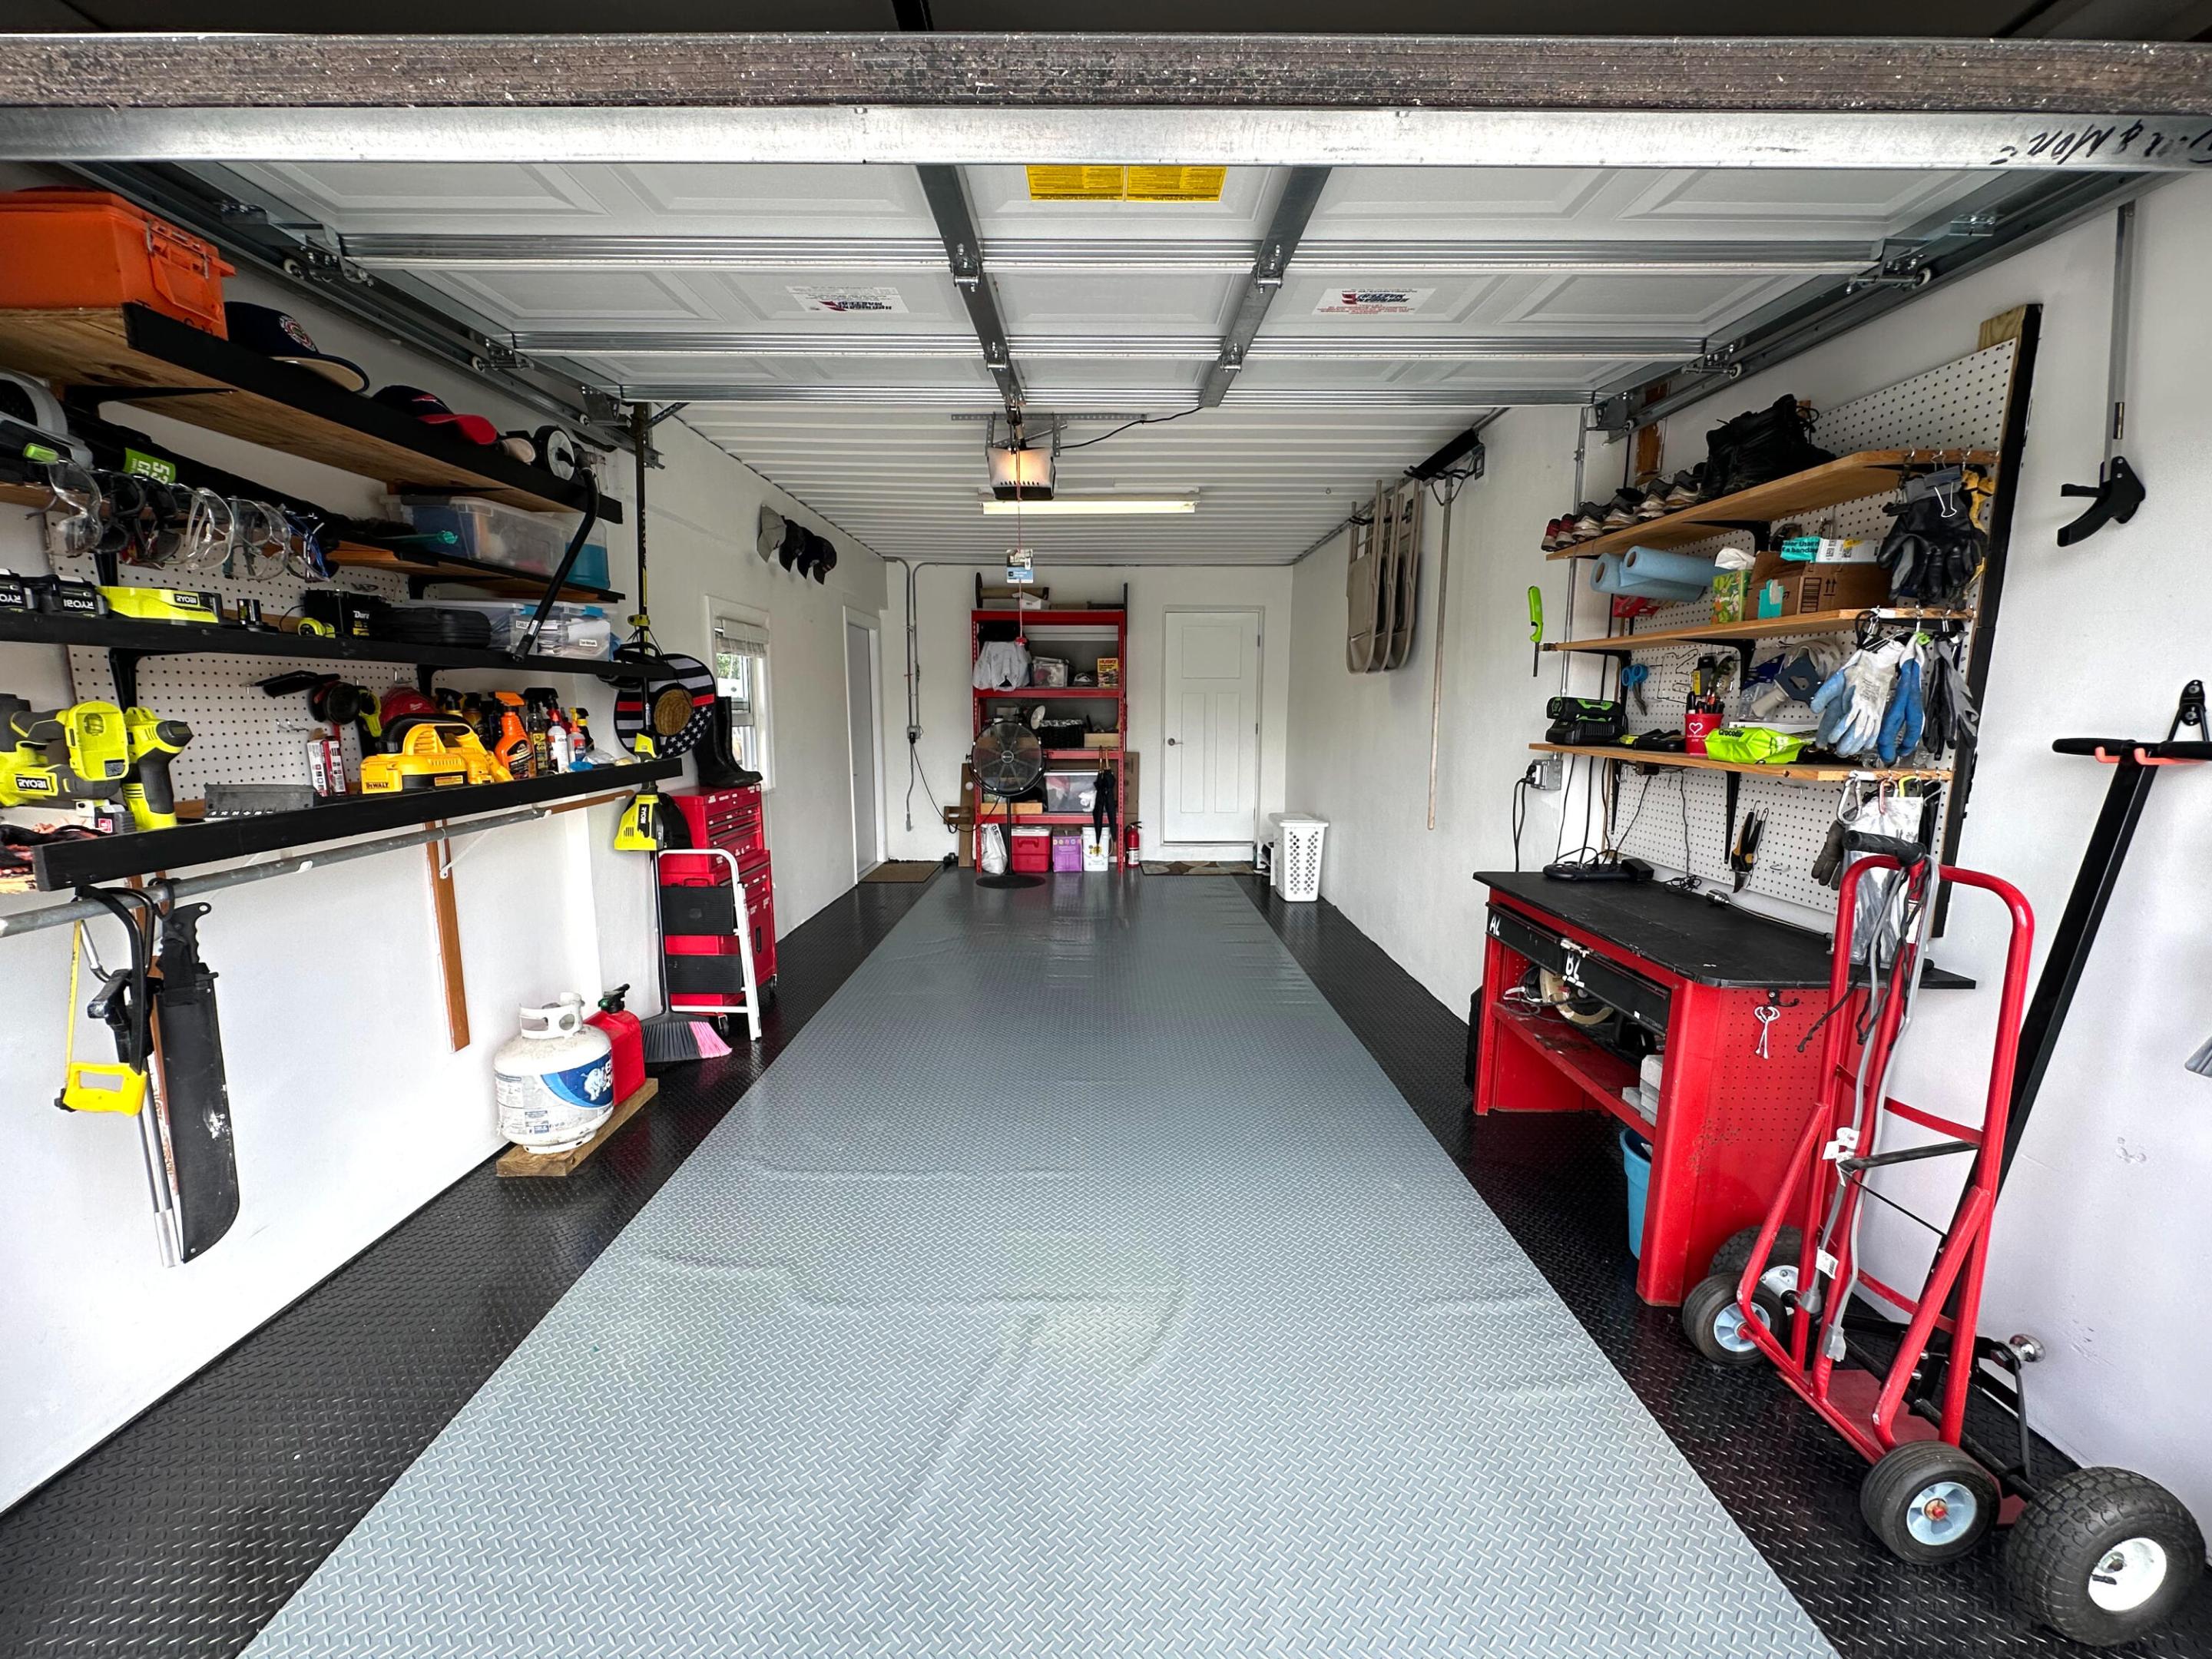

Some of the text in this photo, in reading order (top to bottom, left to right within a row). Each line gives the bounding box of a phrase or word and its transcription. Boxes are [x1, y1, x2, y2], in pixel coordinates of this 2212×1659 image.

[0, 594, 23, 604] RYO
[176, 594, 197, 604] RYOBI
[63, 599, 95, 610] RYOBI
[17, 778, 48, 790] RYOBI
[366, 781, 389, 790] DEWALT
